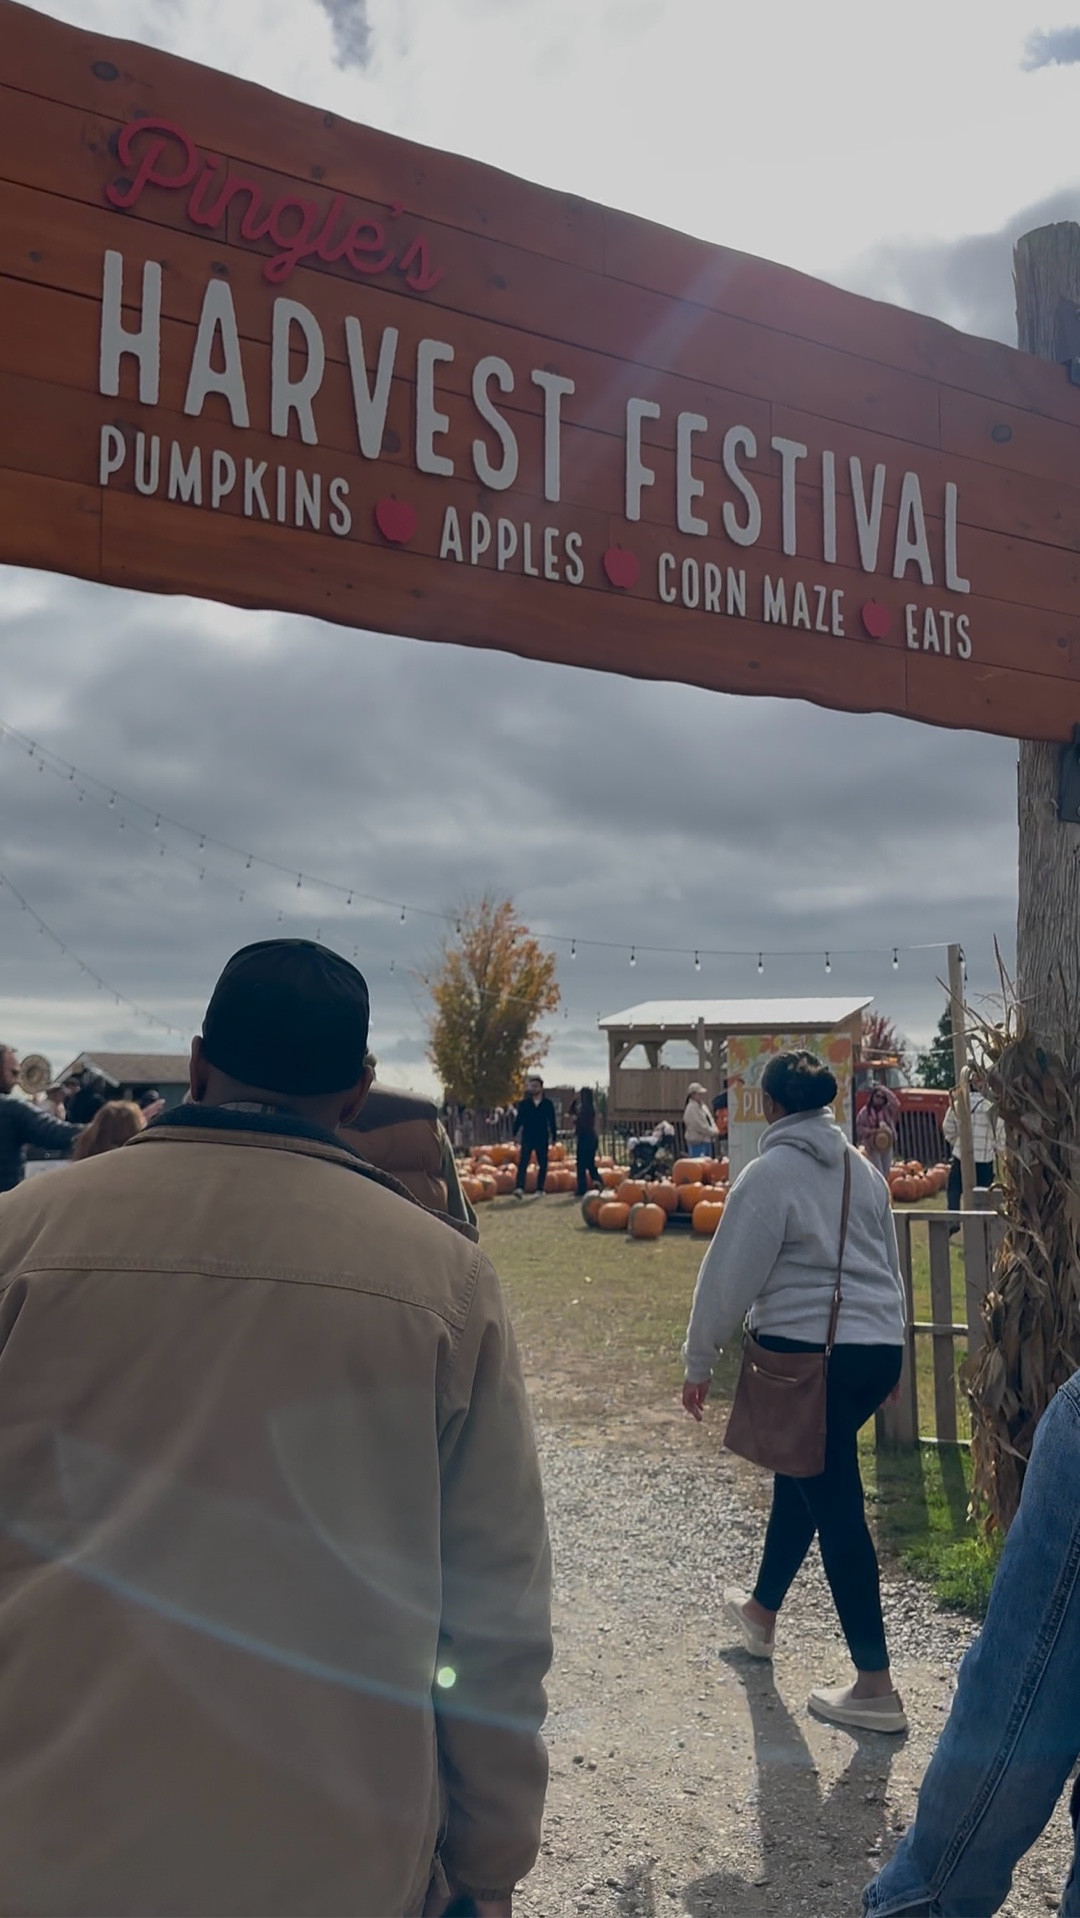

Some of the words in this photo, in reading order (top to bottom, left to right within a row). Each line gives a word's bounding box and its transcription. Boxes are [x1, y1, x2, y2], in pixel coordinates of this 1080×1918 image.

[106, 117, 445, 292] Pingle's
[99, 249, 576, 503] HARVEST
[625, 397, 971, 594] FESTIVAL
[99, 424, 353, 536] PUMPKINS
[439, 505, 585, 586] APPLES
[658, 551, 747, 618] CORN
[763, 573, 846, 638] MAZE
[905, 602, 973, 660] EATS
